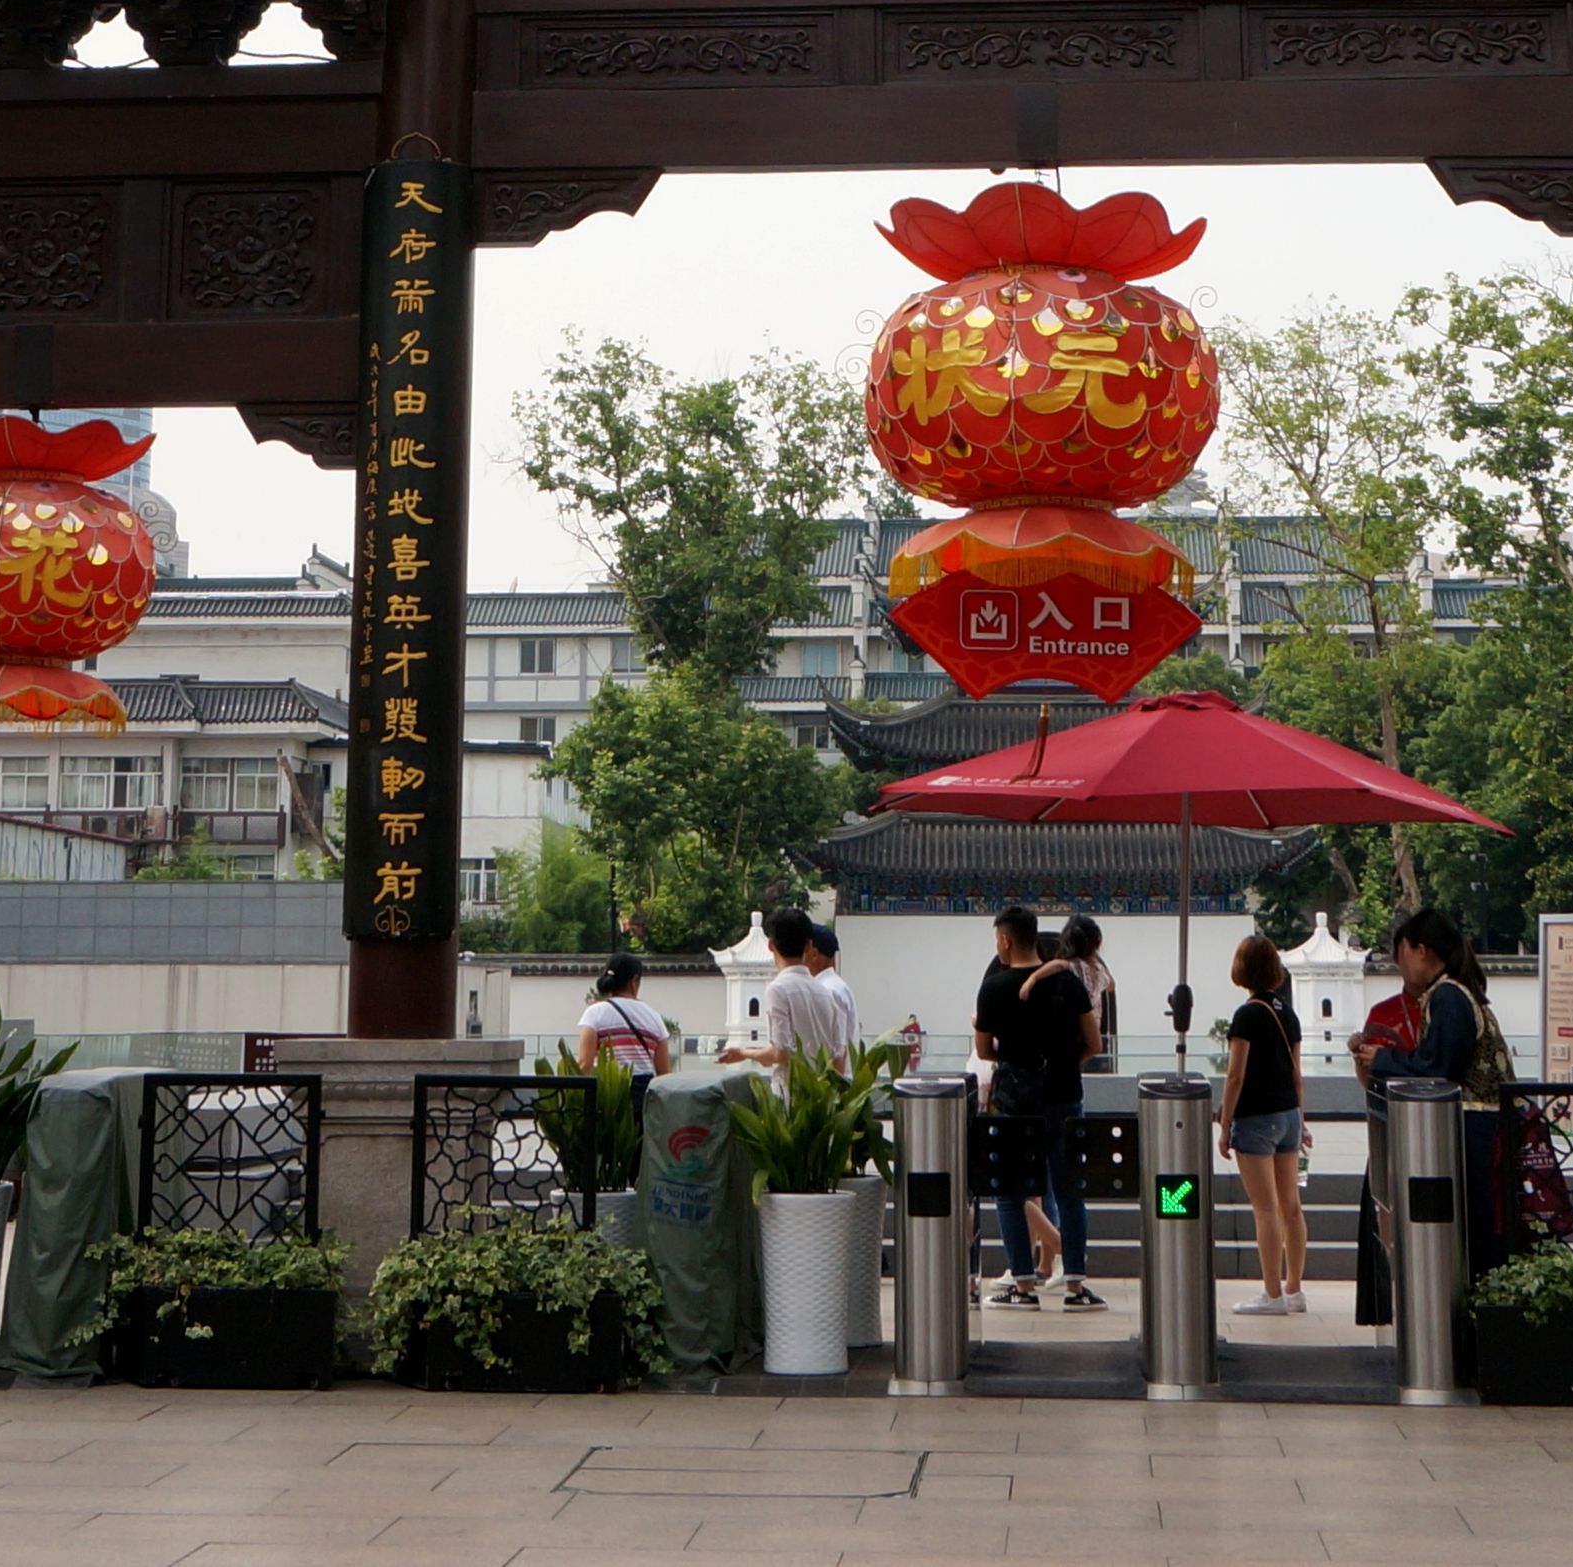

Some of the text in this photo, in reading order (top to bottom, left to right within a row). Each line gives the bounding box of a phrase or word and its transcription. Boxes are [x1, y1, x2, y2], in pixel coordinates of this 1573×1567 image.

[892, 328, 1147, 430] 状元
[1027, 590, 1131, 632] 入口
[1028, 635, 1130, 657] Entrance
